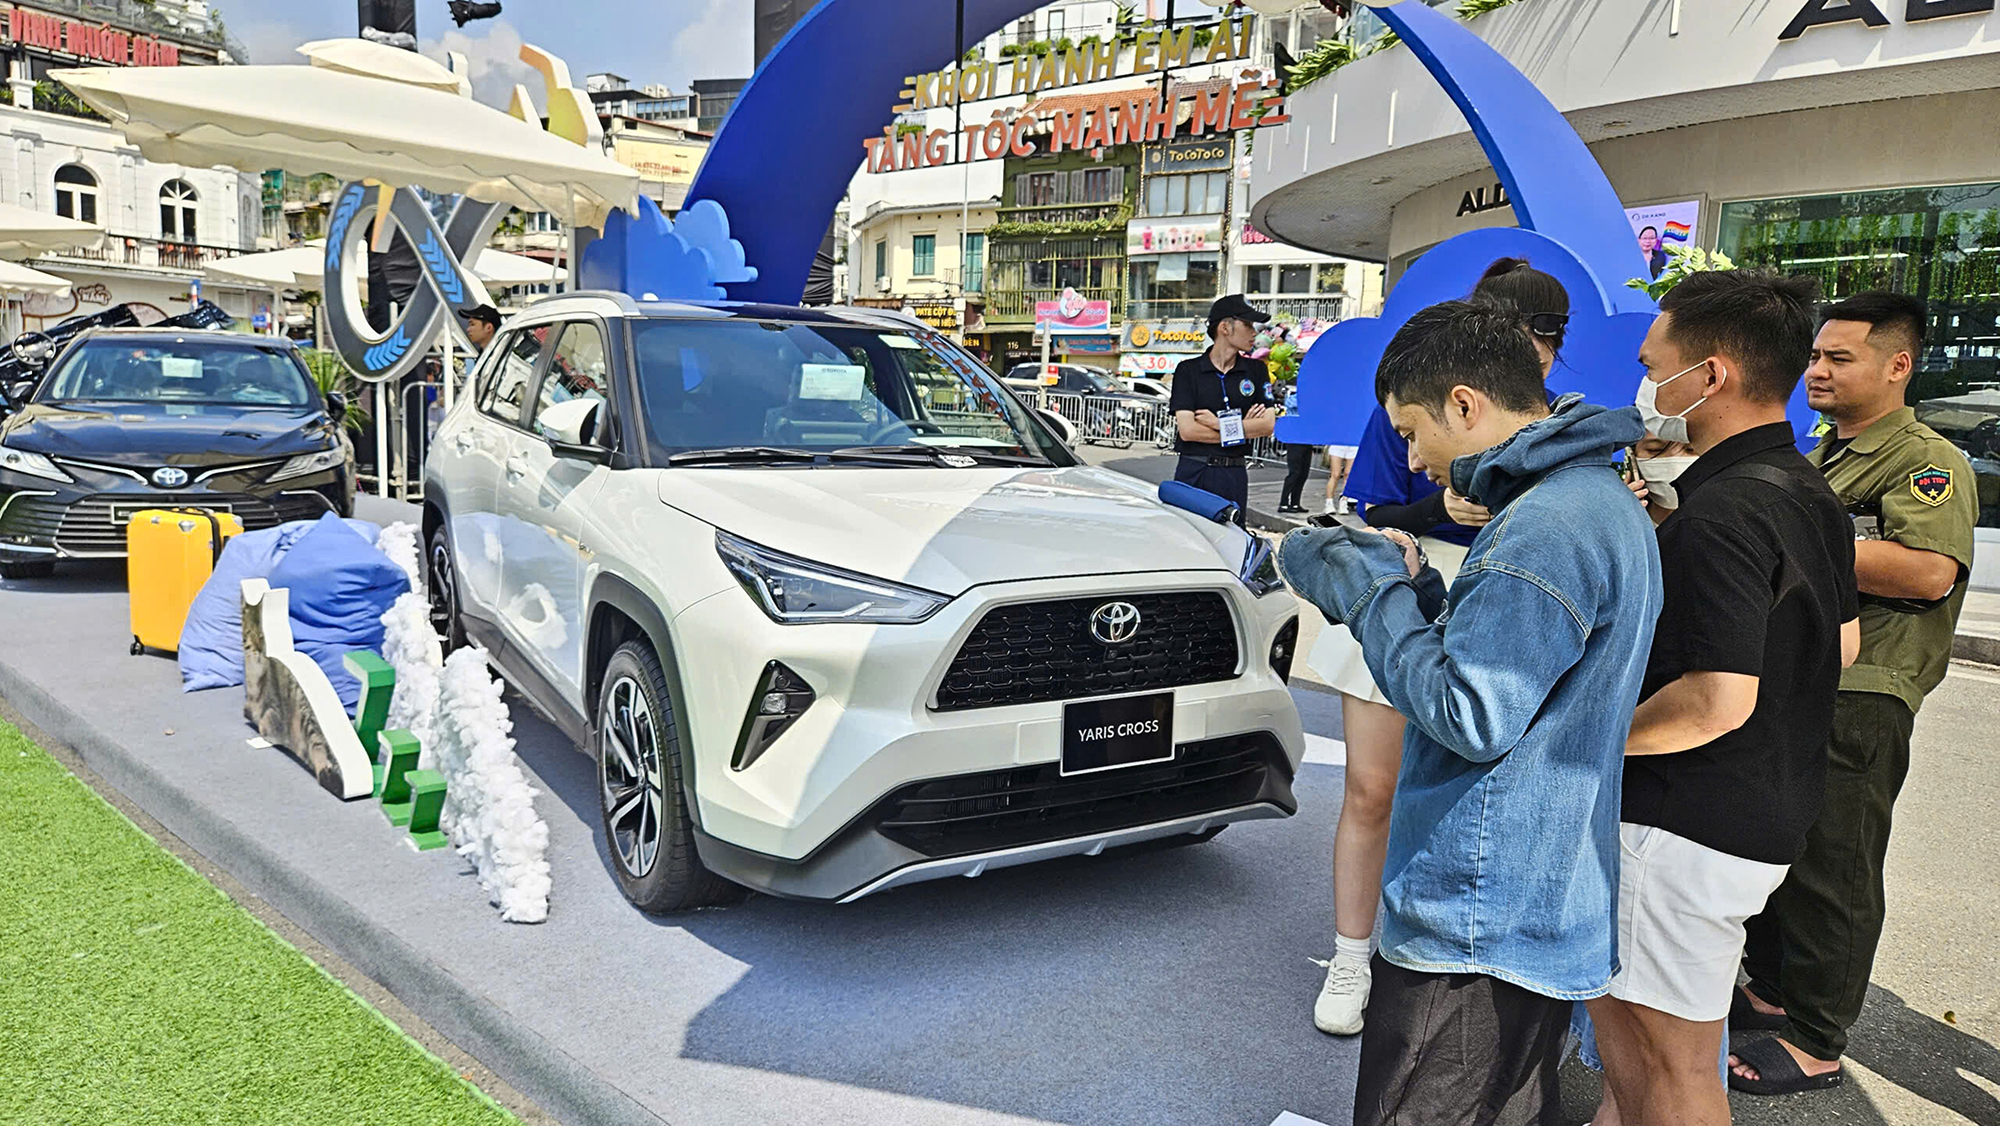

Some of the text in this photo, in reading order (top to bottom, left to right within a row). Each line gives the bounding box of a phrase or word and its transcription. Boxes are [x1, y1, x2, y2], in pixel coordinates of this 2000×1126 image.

[9, 9, 61, 50] VINH
[1134, 19, 1195, 75] ÊM
[1206, 4, 1254, 63] ÁI
[863, 69, 1262, 174] TĂNG TỐC MẠNH MẼ
[1169, 147, 1225, 163] ToCoToCo
[1078, 719, 1159, 742] YARIS CROSS
